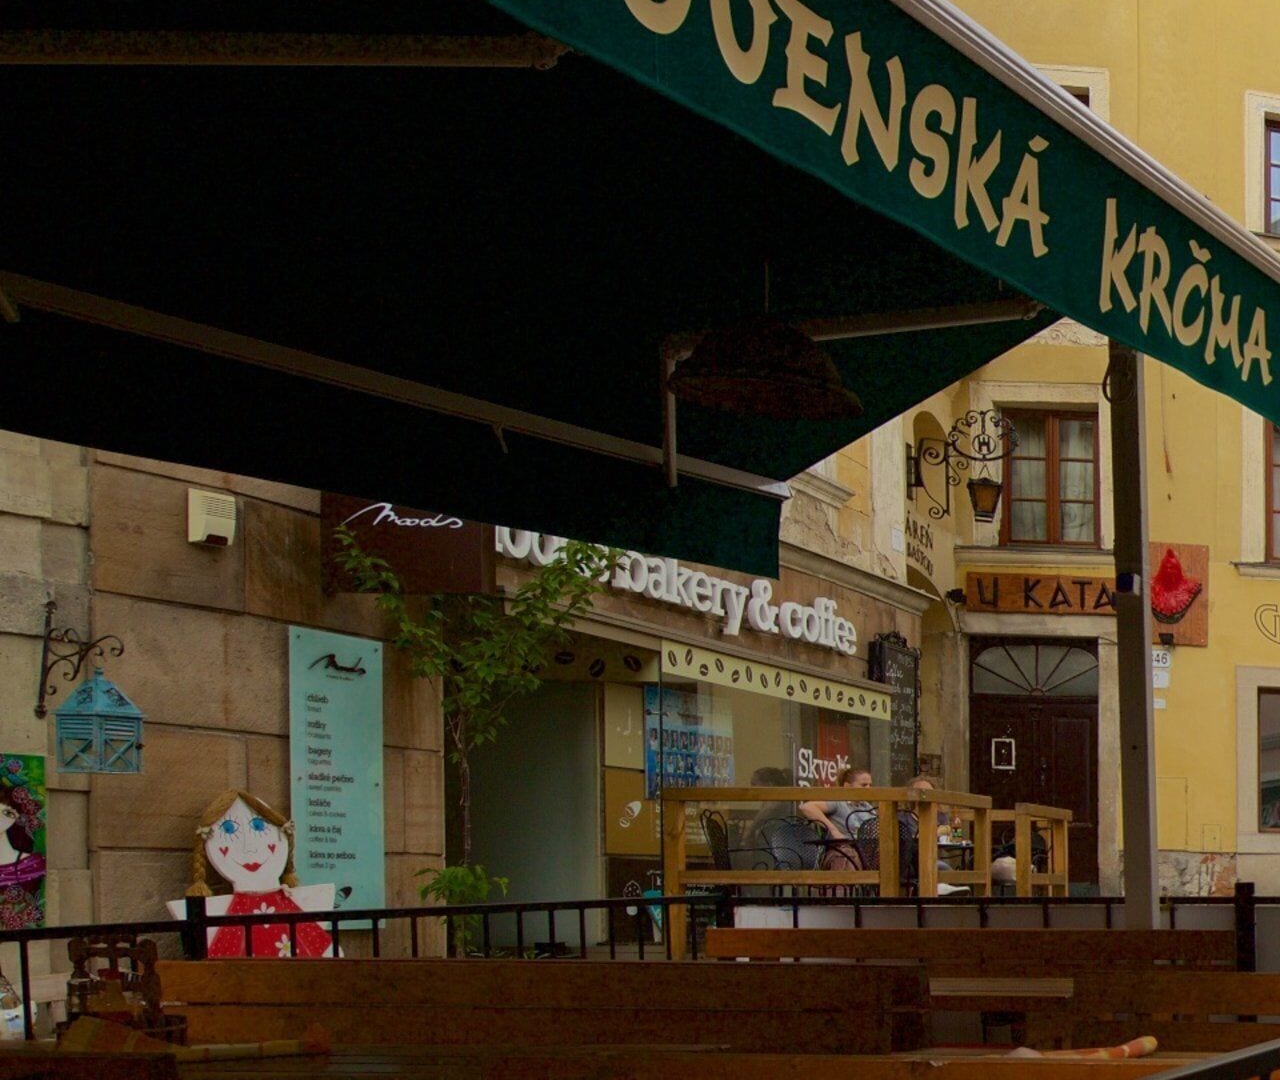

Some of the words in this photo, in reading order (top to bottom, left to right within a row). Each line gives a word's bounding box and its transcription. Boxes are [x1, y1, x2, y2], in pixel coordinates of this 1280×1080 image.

[1099, 197, 1274, 387] KRČMA
[748, 579, 780, 634] &
[779, 596, 857, 655] coffee
[976, 577, 999, 608] U
